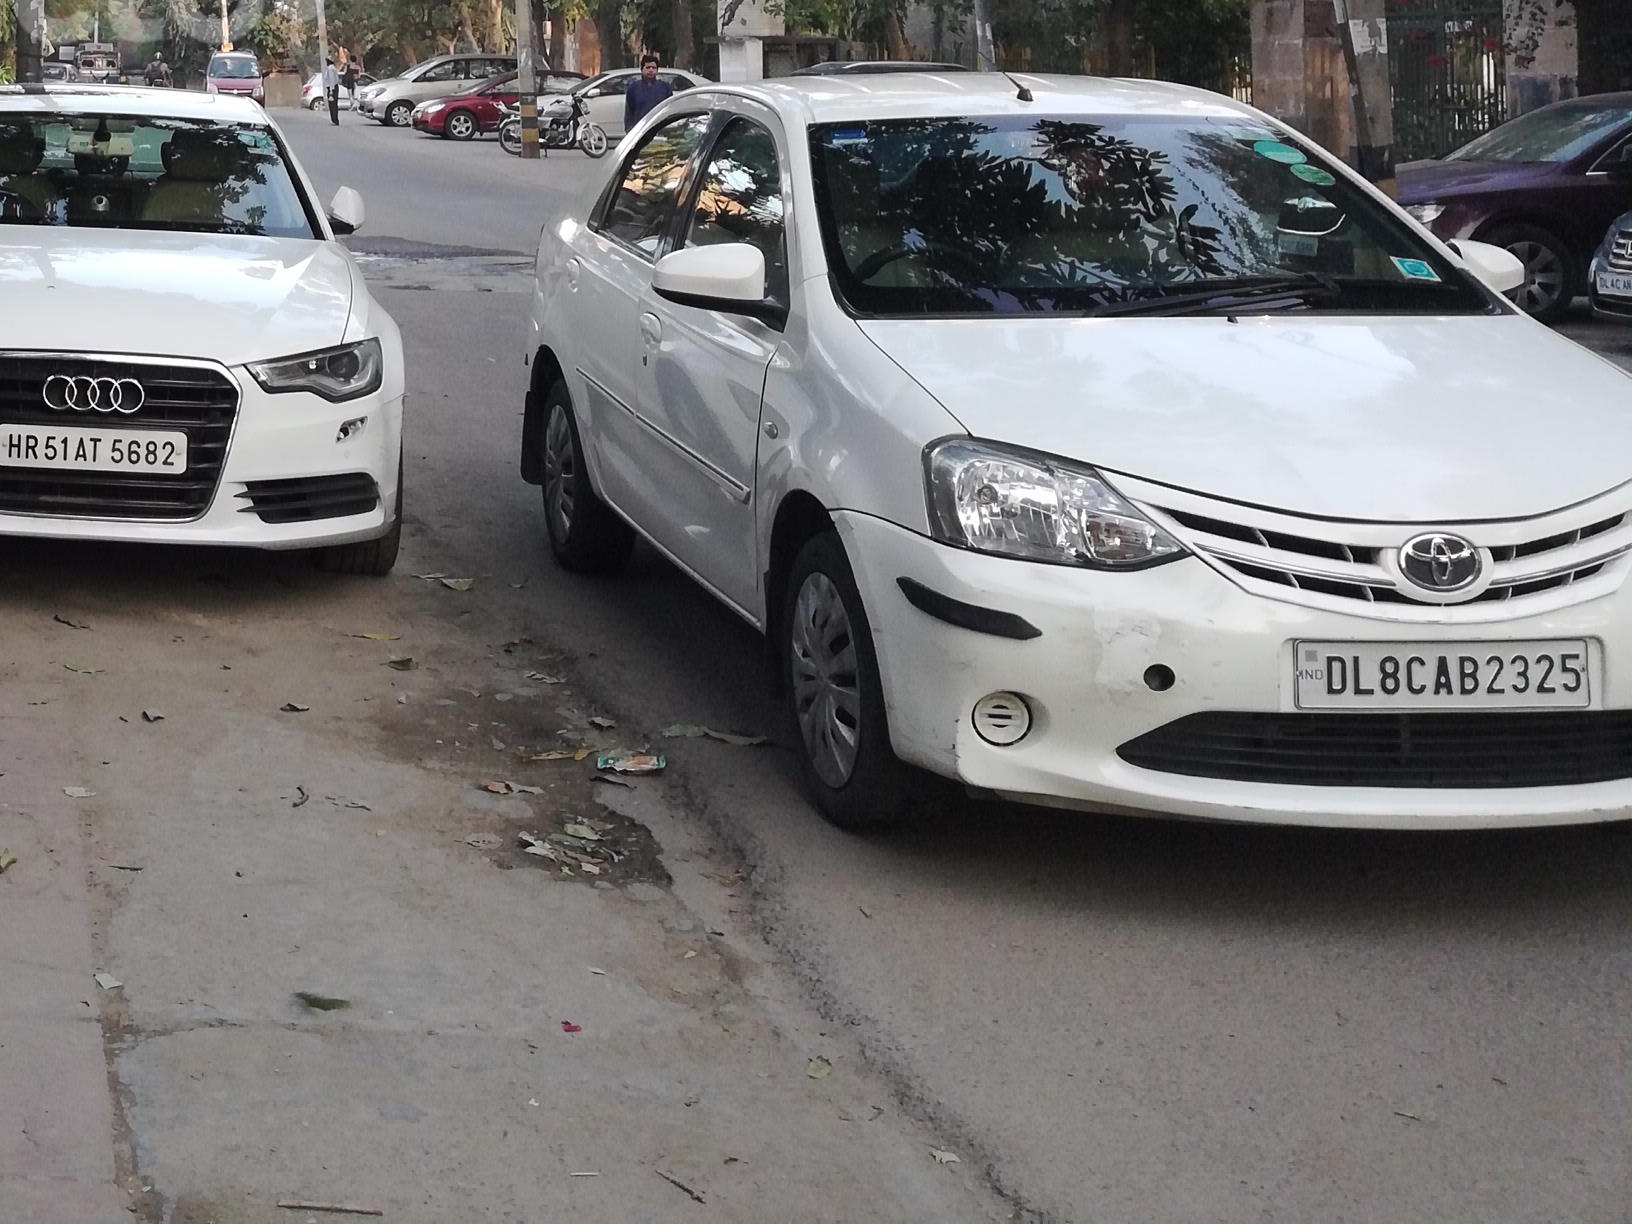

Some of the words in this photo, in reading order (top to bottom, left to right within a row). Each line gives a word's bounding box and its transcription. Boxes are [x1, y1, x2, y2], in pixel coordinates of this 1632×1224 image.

[8, 433, 102, 463] HR51AT
[111, 439, 176, 466] 5682
[1326, 653, 1582, 695] DL8CAB2325
